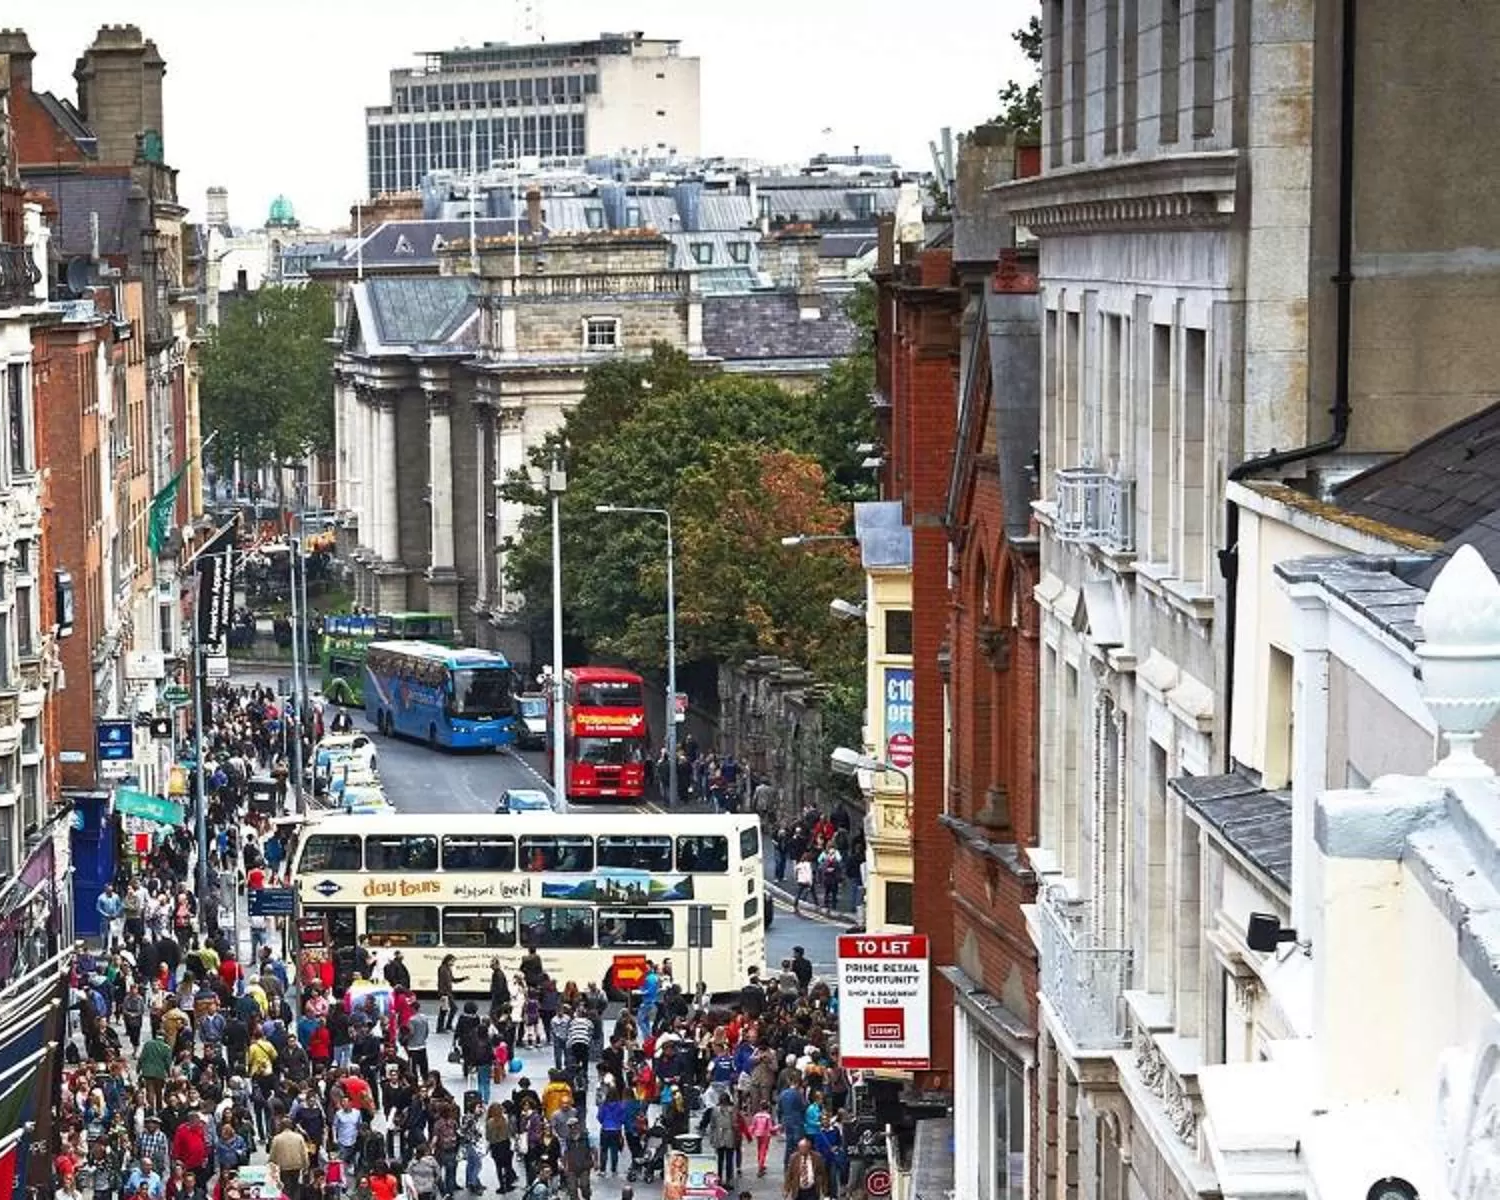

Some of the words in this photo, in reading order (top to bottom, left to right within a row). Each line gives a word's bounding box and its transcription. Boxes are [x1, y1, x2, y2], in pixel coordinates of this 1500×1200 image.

[363, 878, 397, 897] day
[399, 879, 441, 897] tours
[856, 941, 878, 954] TO
[882, 941, 911, 954] LET
[845, 963, 879, 973] PRIME
[883, 963, 920, 973] RETAIL
[845, 975, 920, 985] OPPORTUNITY
